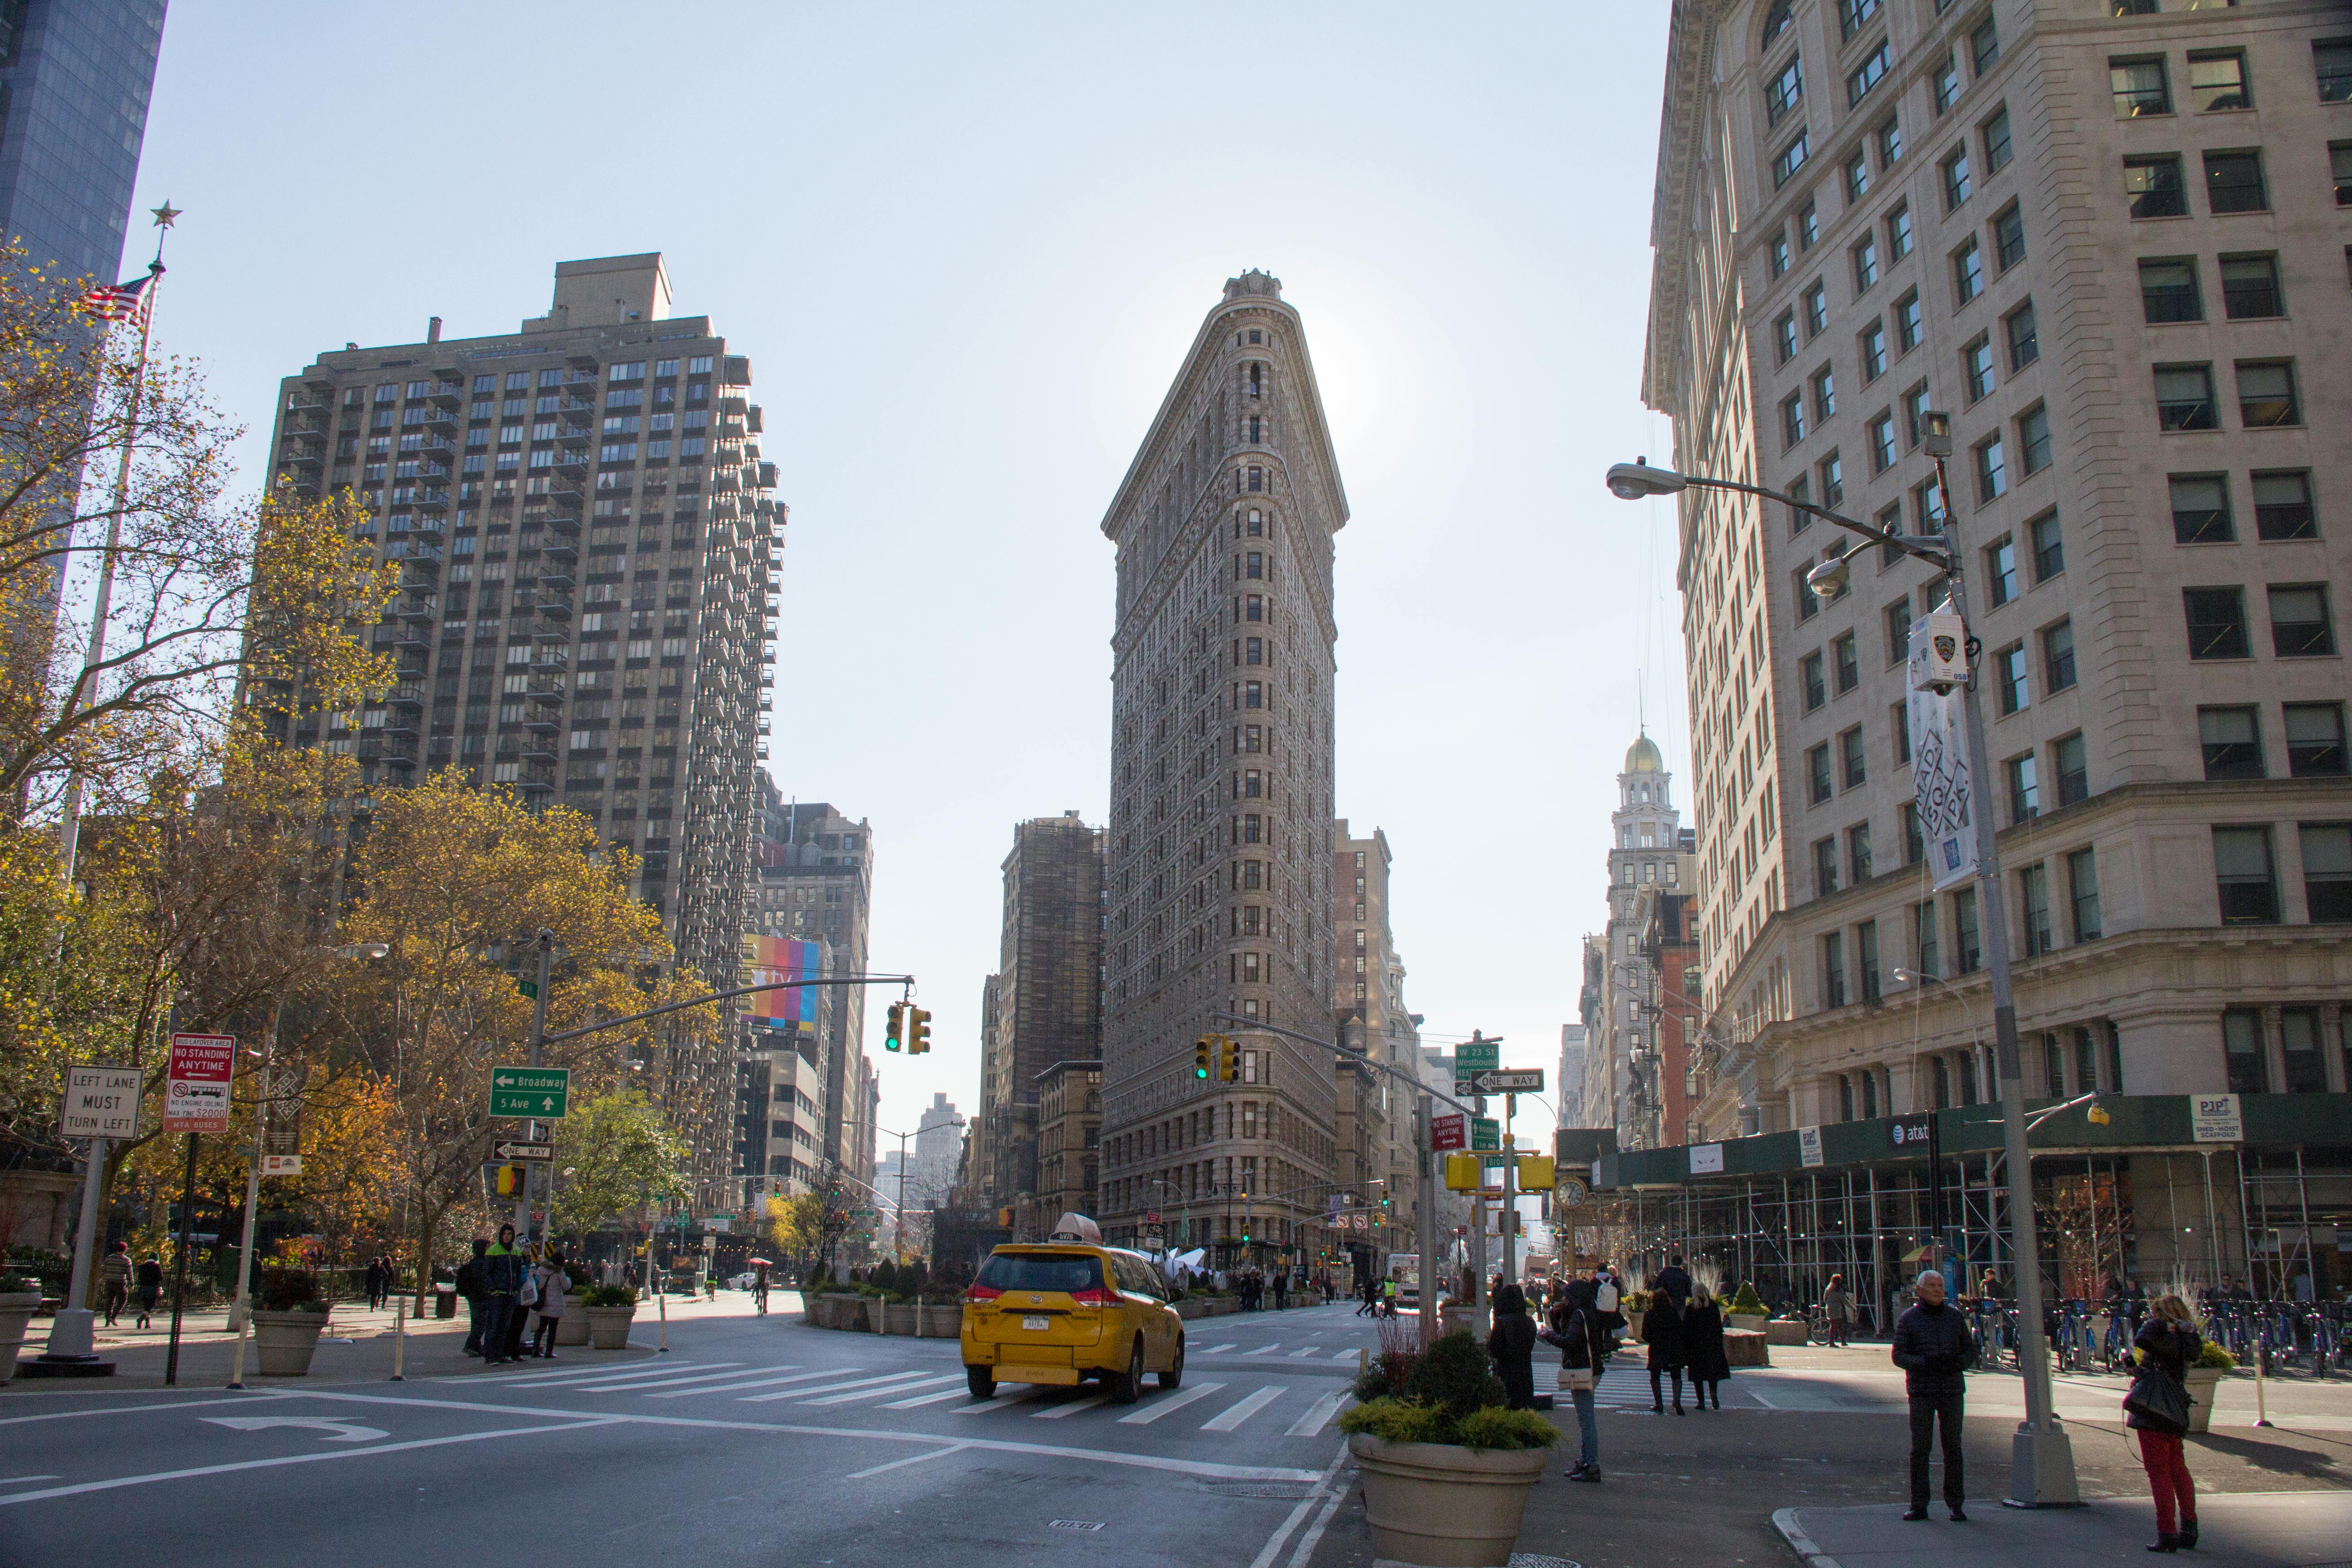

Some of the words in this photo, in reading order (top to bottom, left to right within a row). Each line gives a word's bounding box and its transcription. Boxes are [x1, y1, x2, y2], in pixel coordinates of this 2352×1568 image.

[1947, 780, 1968, 817] PK.
[770, 970, 792, 990] tv
[175, 1049, 186, 1057] NO
[189, 1049, 230, 1059] STANDING
[178, 1060, 225, 1071] ANYTIME
[1457, 1058, 1497, 1066] Westbound
[74, 1075, 102, 1087] LEFT
[107, 1077, 136, 1088] LANE
[518, 1077, 566, 1090] Broadway
[1482, 1077, 1502, 1086] ONE
[1512, 1076, 1534, 1086] WAY
[83, 1095, 122, 1109] MUST
[501, 1098, 506, 1108] 5
[510, 1098, 529, 1108] Ave
[2200, 1101, 2224, 1112] PJP
[196, 1108, 225, 1118] $2000
[69, 1117, 98, 1128] TURN
[104, 1118, 132, 1130] LEFT
[1441, 1117, 1462, 1127] STANDING
[1437, 1127, 1460, 1137] ANYTIME
[1907, 1124, 1929, 1140] at&t
[503, 1147, 520, 1155] ONE
[529, 1147, 547, 1156] WAY
